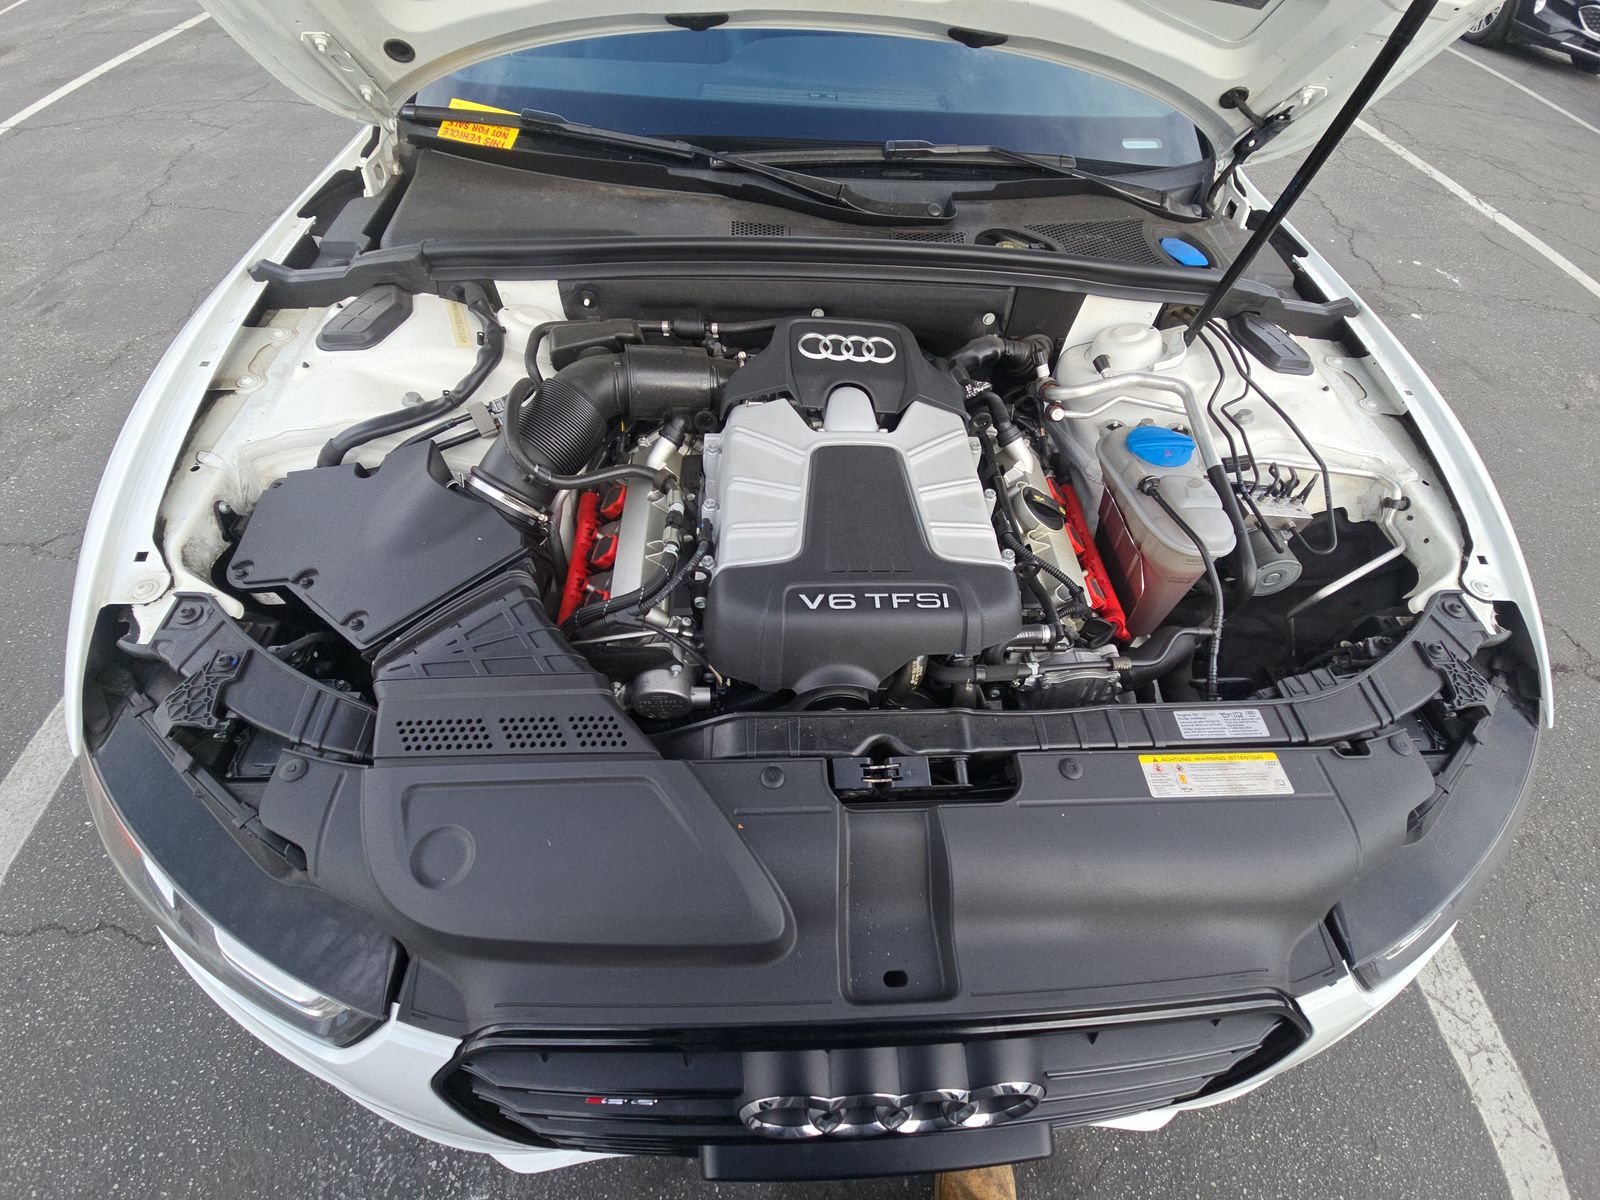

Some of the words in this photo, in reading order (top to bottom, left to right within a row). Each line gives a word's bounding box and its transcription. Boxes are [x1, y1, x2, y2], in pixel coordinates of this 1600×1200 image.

[442, 127, 482, 143] VEHICLE
[472, 124, 490, 134] FOR
[492, 130, 509, 139] NOT
[484, 137, 506, 149] THIS
[799, 593, 857, 610] V6
[864, 592, 950, 609] TFSI
